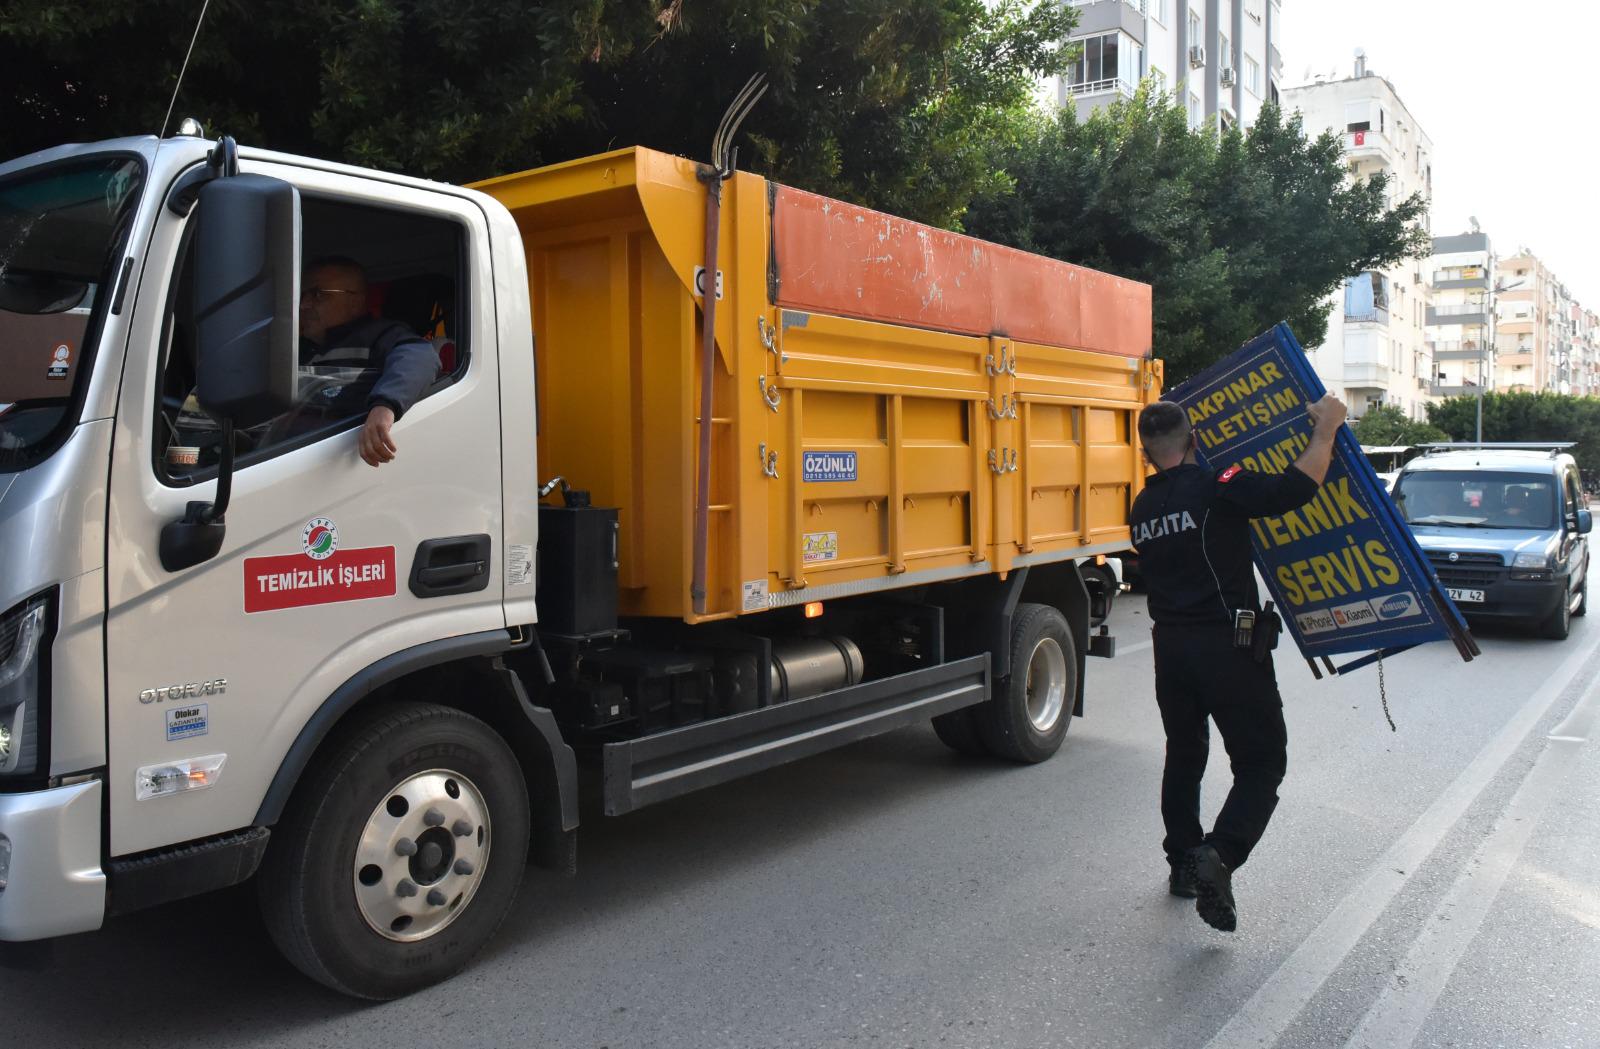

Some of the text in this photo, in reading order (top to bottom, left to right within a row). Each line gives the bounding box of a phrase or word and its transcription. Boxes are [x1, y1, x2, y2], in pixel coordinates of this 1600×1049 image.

[696, 268, 721, 298] C
[1187, 361, 1284, 426] AKPINAR
[1197, 387, 1300, 449] İLETİŞİM
[805, 454, 855, 473] ÖZÜNLÜ
[257, 559, 386, 593] TEMİZLİK İŞLERİ
[1276, 534, 1400, 606] SERVİS
[1446, 589, 1482, 601] ZV 42
[1304, 600, 1409, 630] iPhone Xiaomi SAMSUNG
[139, 678, 227, 704] OTOKAR
[175, 708, 200, 719] Otokar
